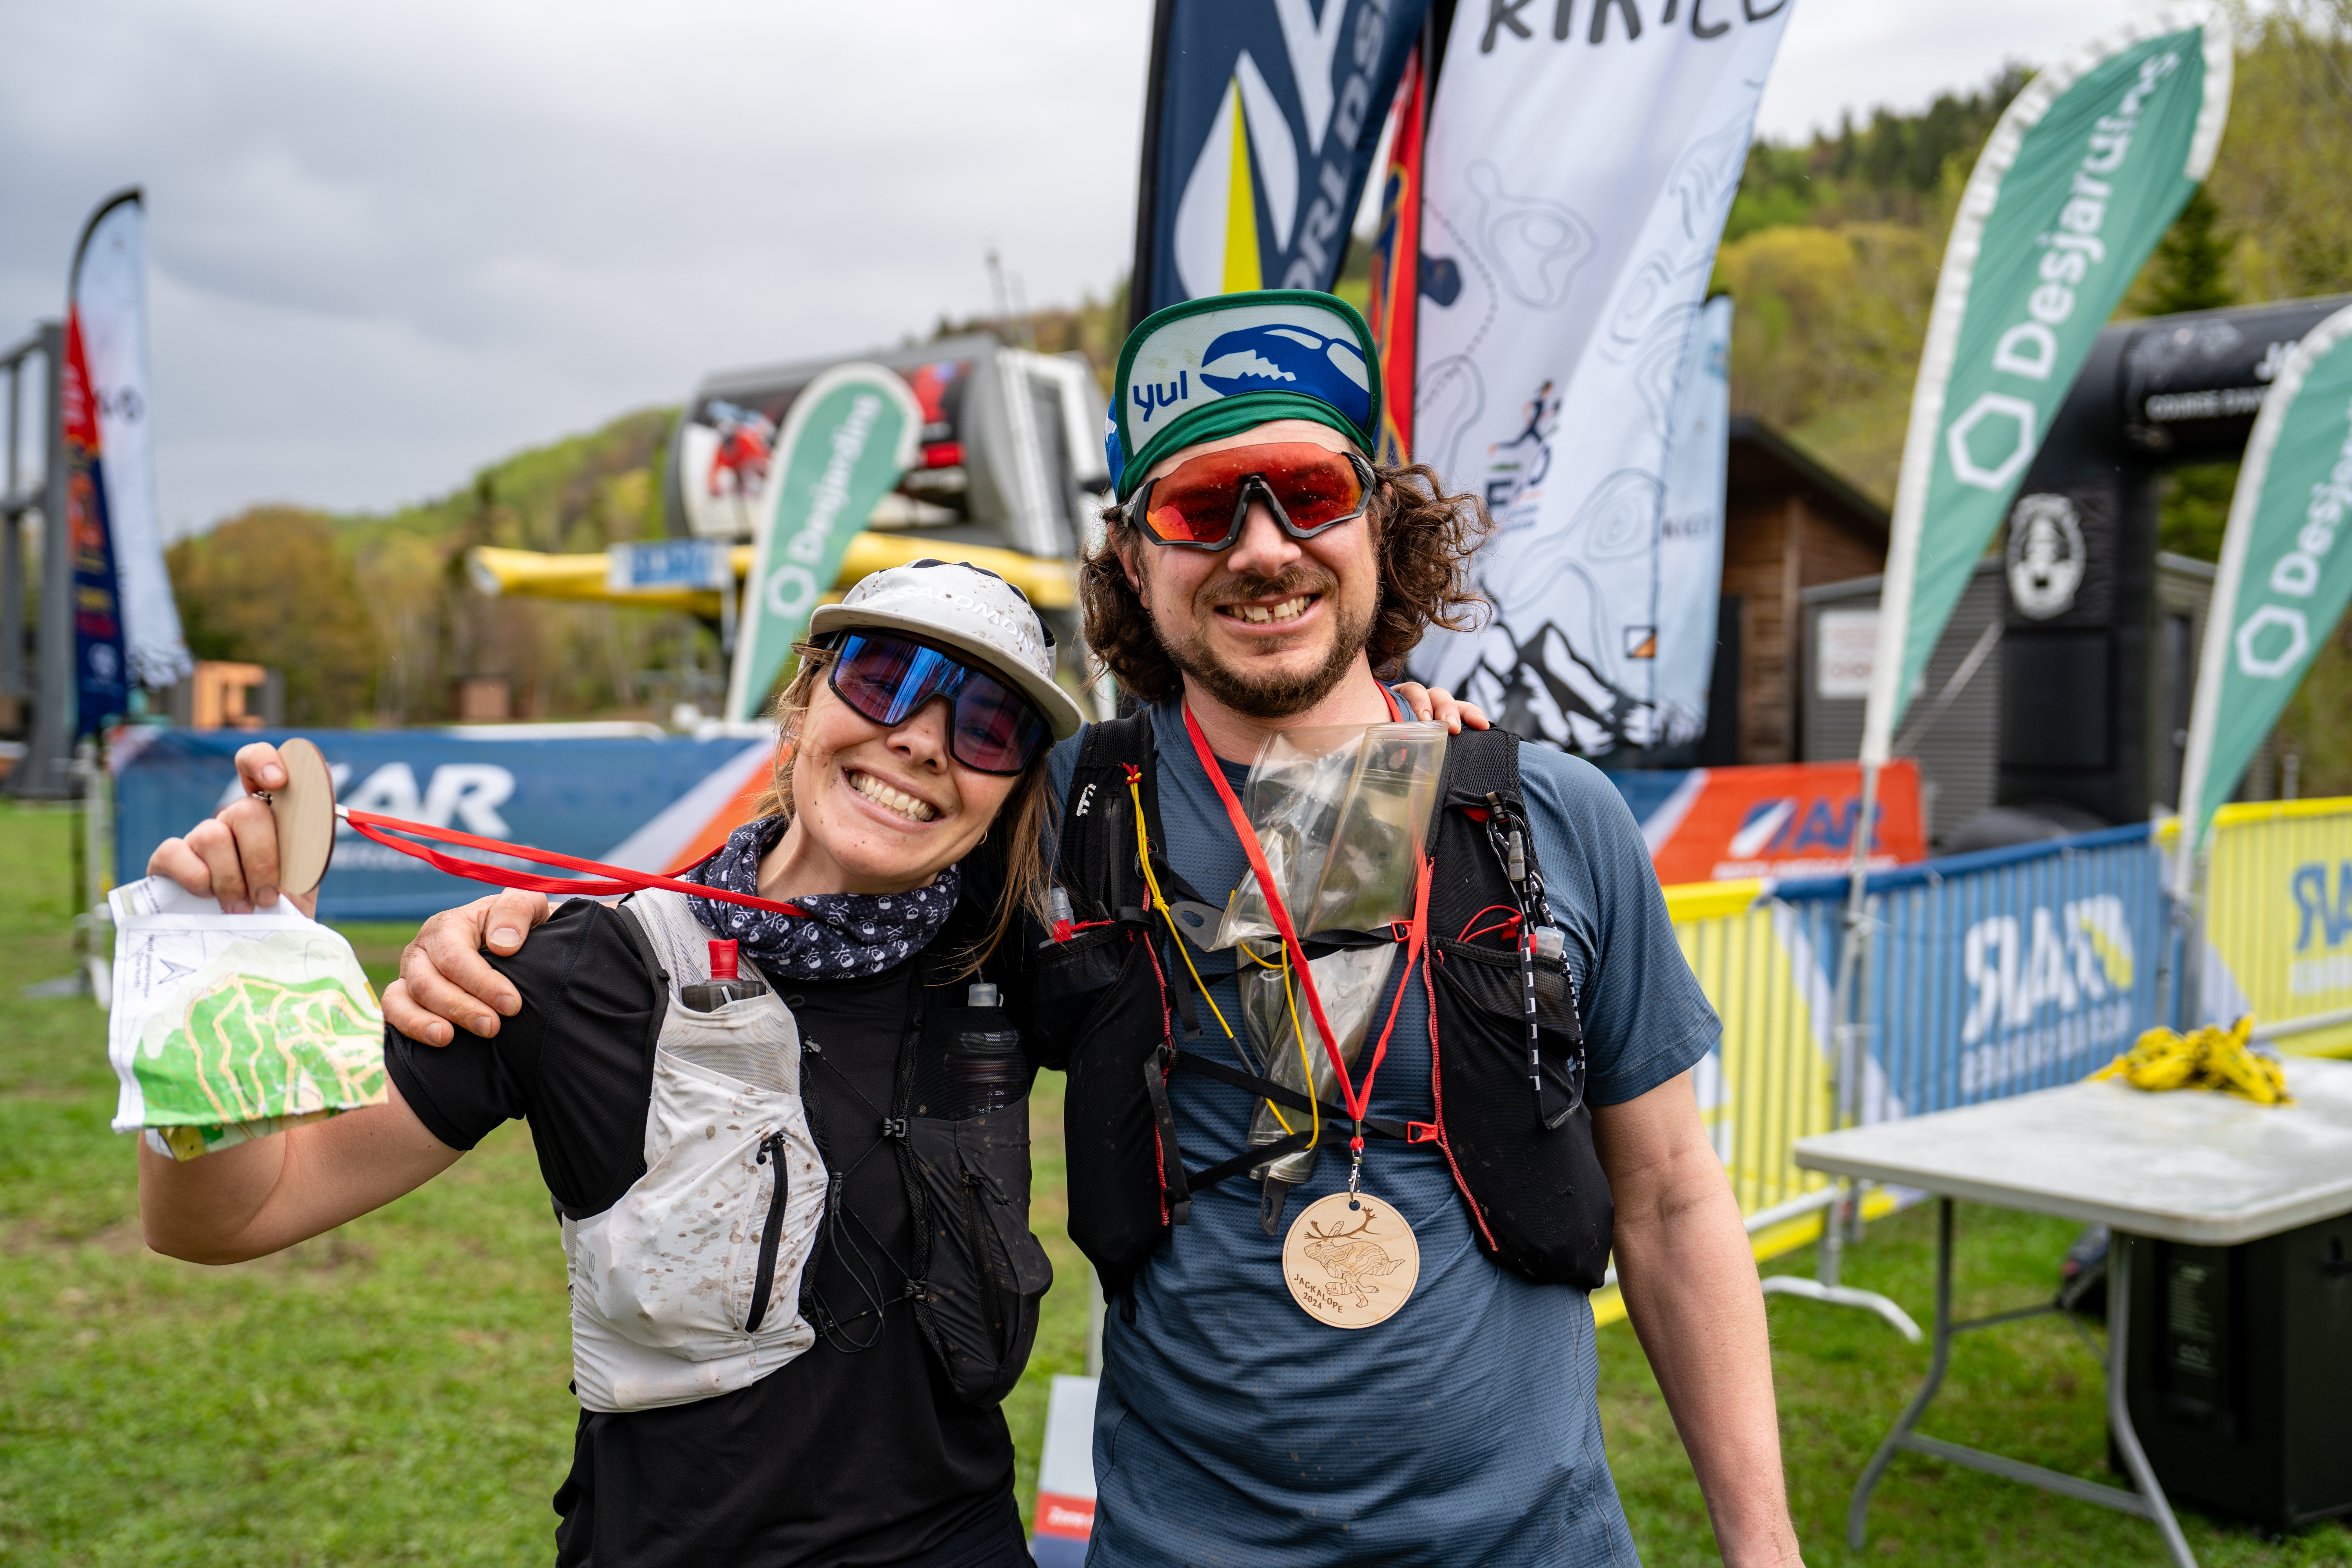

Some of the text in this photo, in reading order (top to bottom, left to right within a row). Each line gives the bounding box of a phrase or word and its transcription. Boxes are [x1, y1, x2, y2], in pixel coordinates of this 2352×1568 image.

[1133, 370, 1188, 422] yul
[2270, 392, 2352, 598] Desja
[897, 586, 1035, 655] SALOMON
[1294, 1274, 1343, 1313] JACKALOPE
[1303, 1292, 1322, 1309] 2024
